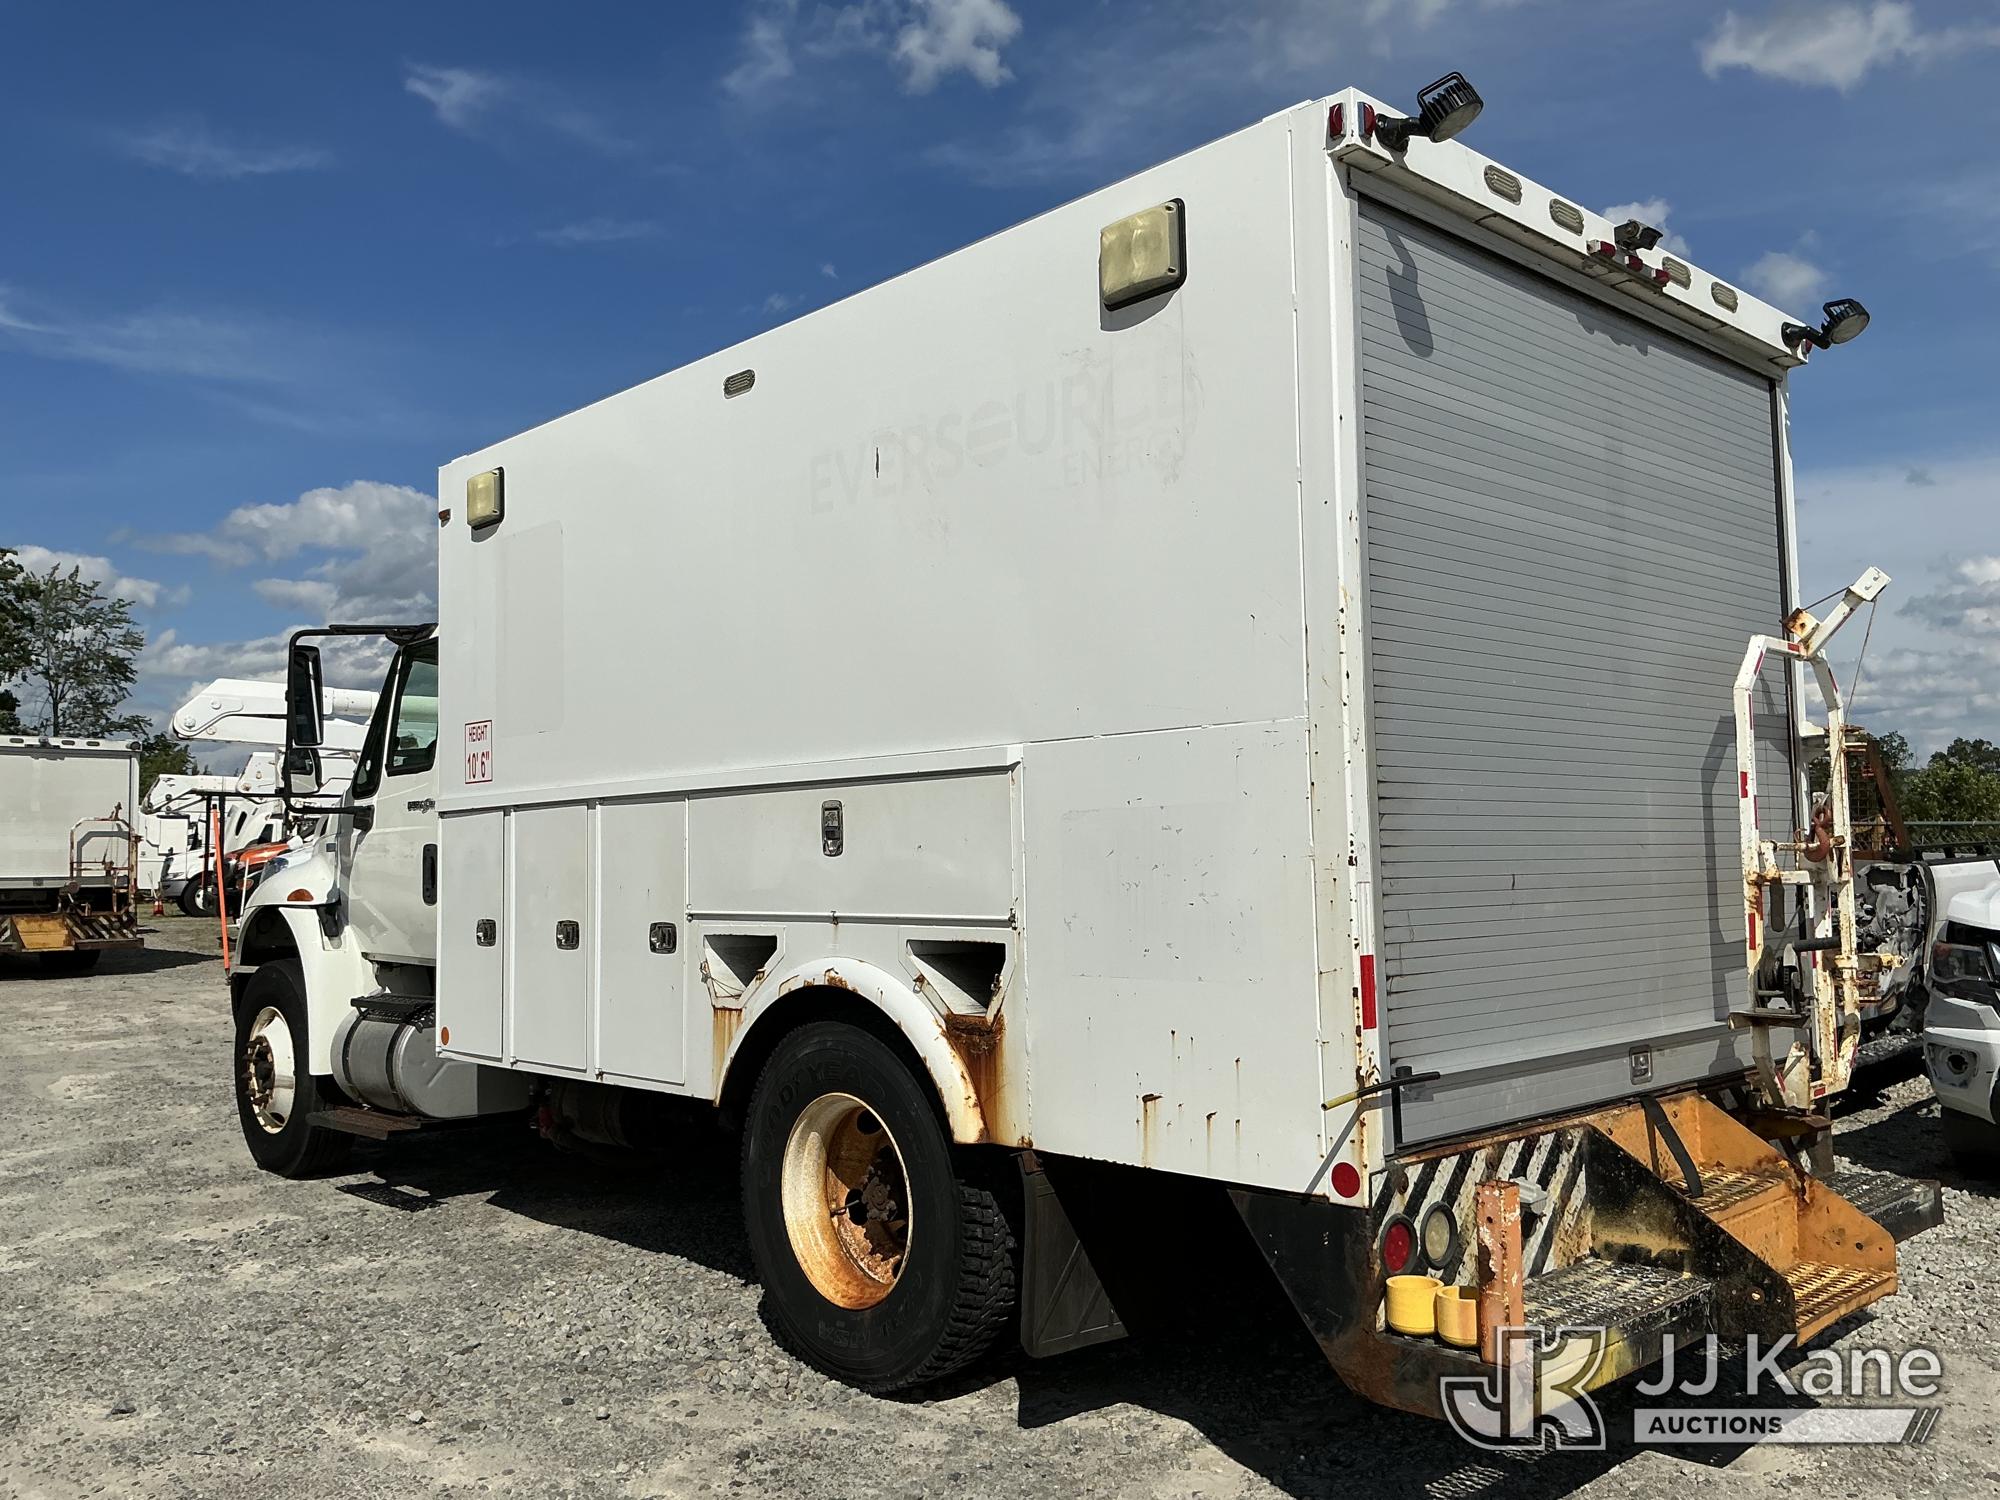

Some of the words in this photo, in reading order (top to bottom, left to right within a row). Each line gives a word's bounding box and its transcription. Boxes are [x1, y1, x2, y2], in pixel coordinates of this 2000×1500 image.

[469, 725, 488, 742] HEIGHT
[468, 752, 479, 779] 10'
[481, 751, 490, 778] 6"
